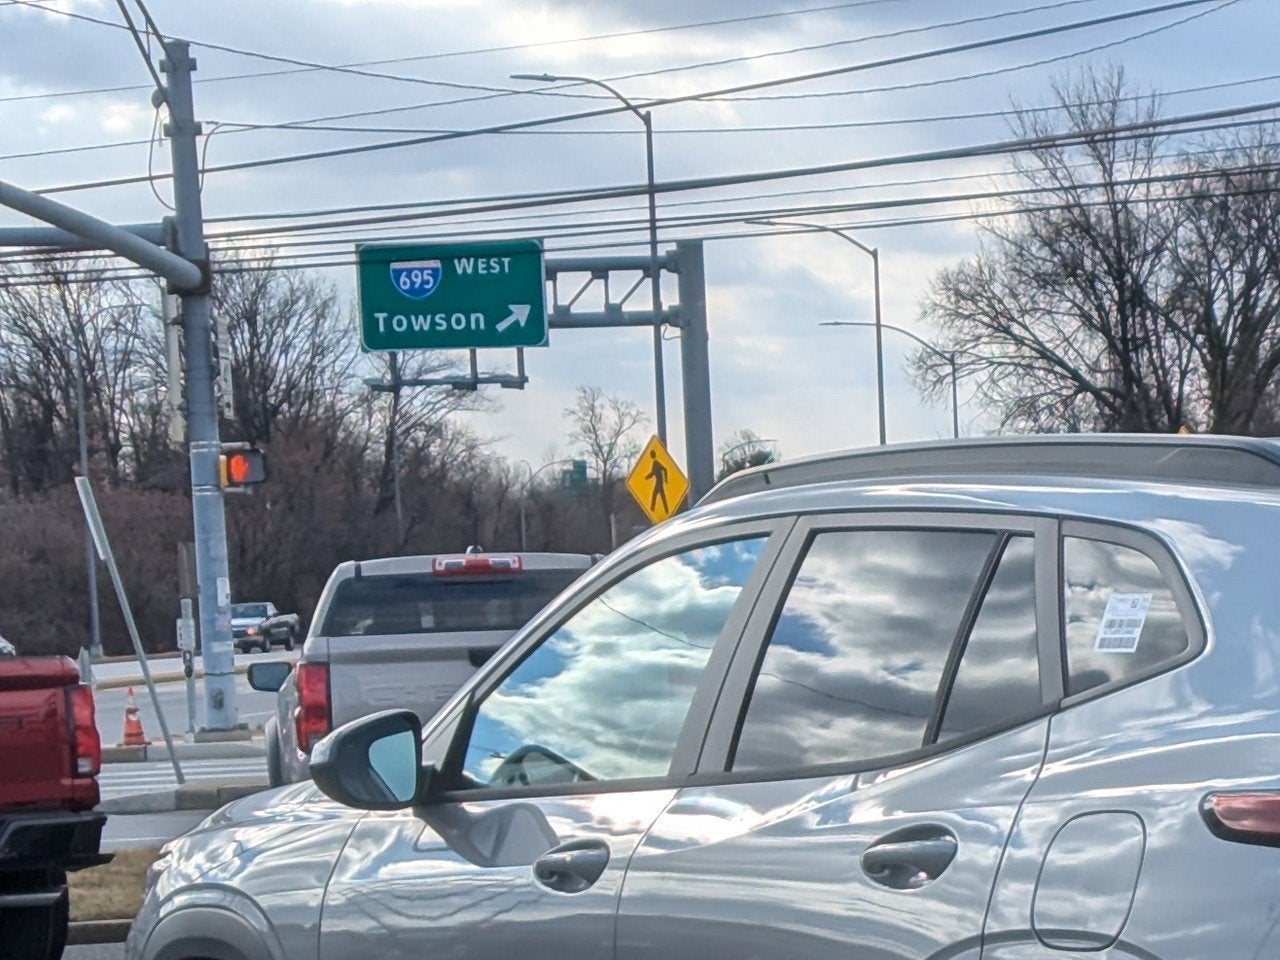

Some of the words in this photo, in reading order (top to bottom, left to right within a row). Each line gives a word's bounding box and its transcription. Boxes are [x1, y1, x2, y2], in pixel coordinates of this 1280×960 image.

[399, 269, 434, 290] 695
[453, 257, 512, 275] WEST
[374, 312, 486, 334] Towson
